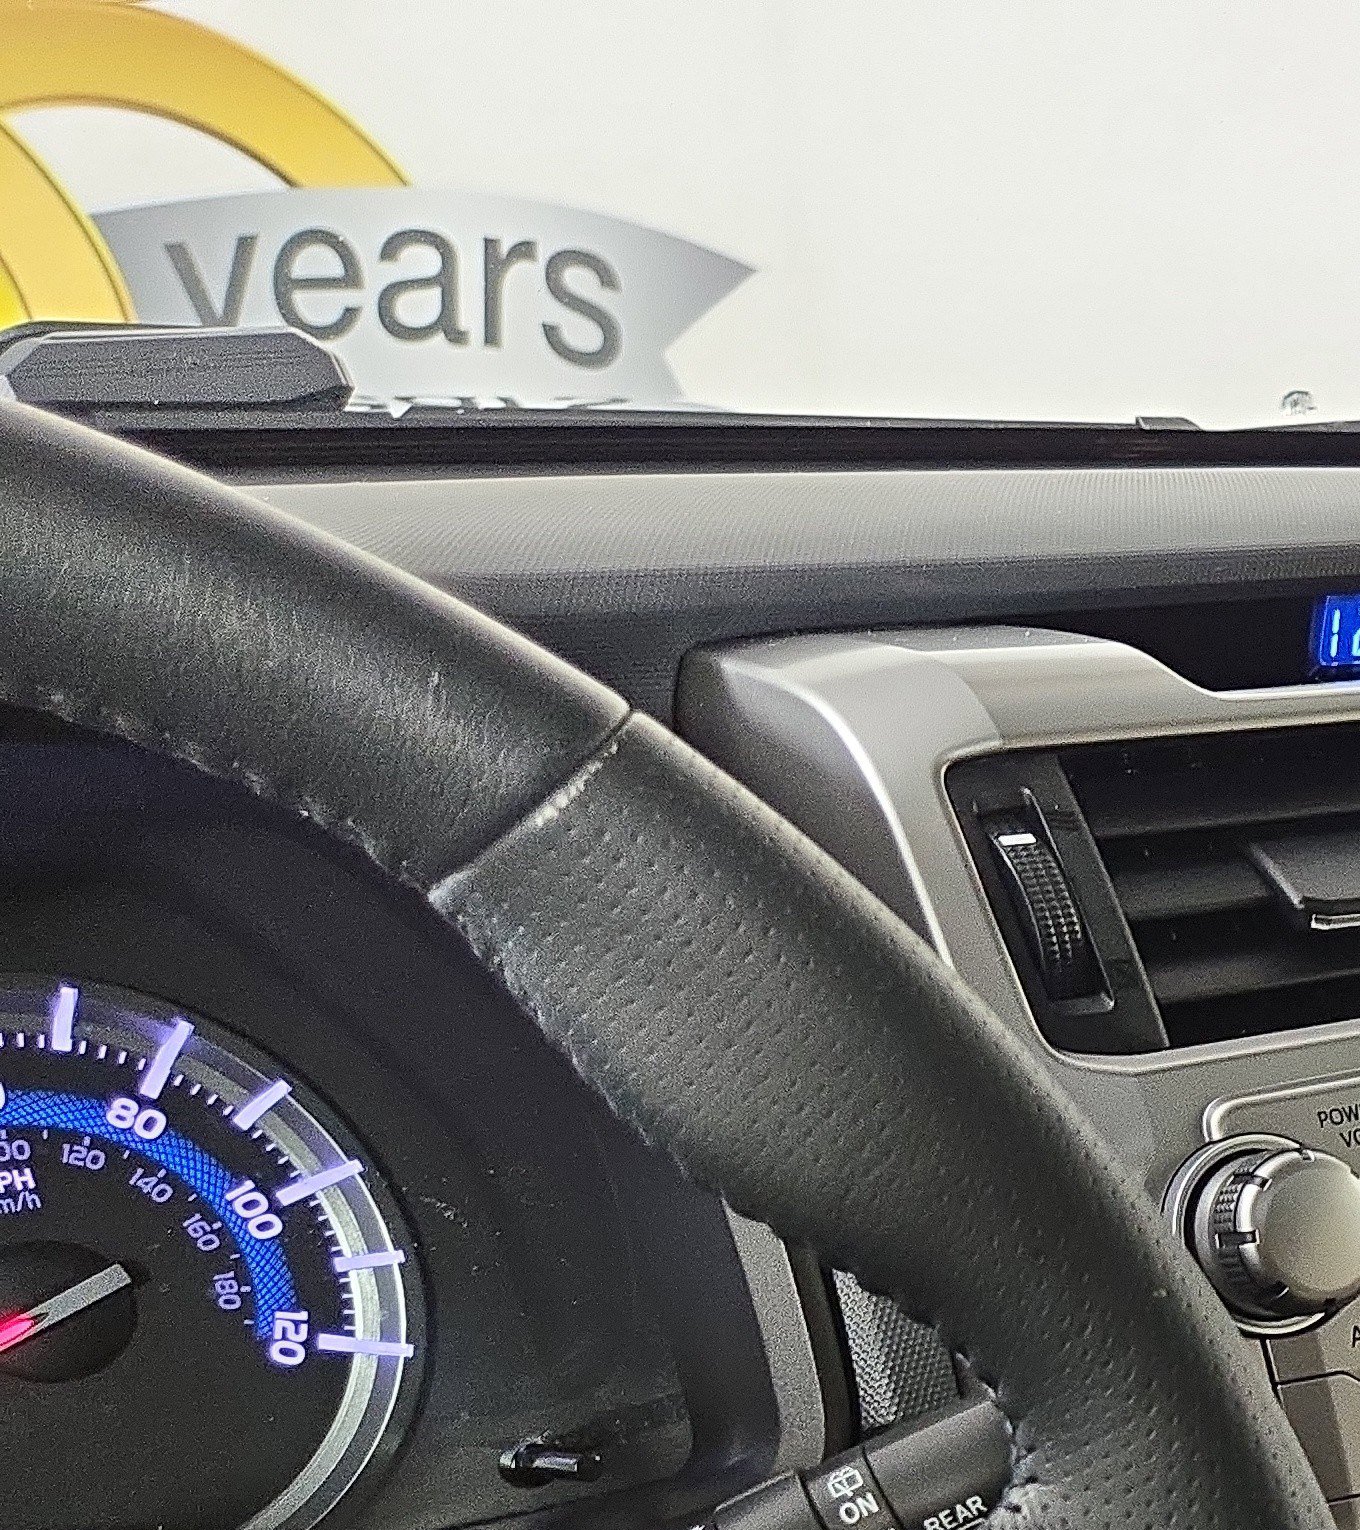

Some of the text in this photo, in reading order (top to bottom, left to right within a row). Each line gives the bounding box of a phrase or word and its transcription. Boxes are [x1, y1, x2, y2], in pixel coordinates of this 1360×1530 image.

[104, 1096, 168, 1140] 80
[61, 1142, 106, 1171] 120
[0, 1167, 37, 1194] PH
[128, 1168, 174, 1204] 140
[0, 1190, 42, 1215] m/h
[224, 1178, 283, 1241] 100
[182, 1213, 222, 1252] 160
[212, 1271, 242, 1312] 180
[268, 1310, 309, 1367] 120
[838, 1492, 880, 1526] ON
